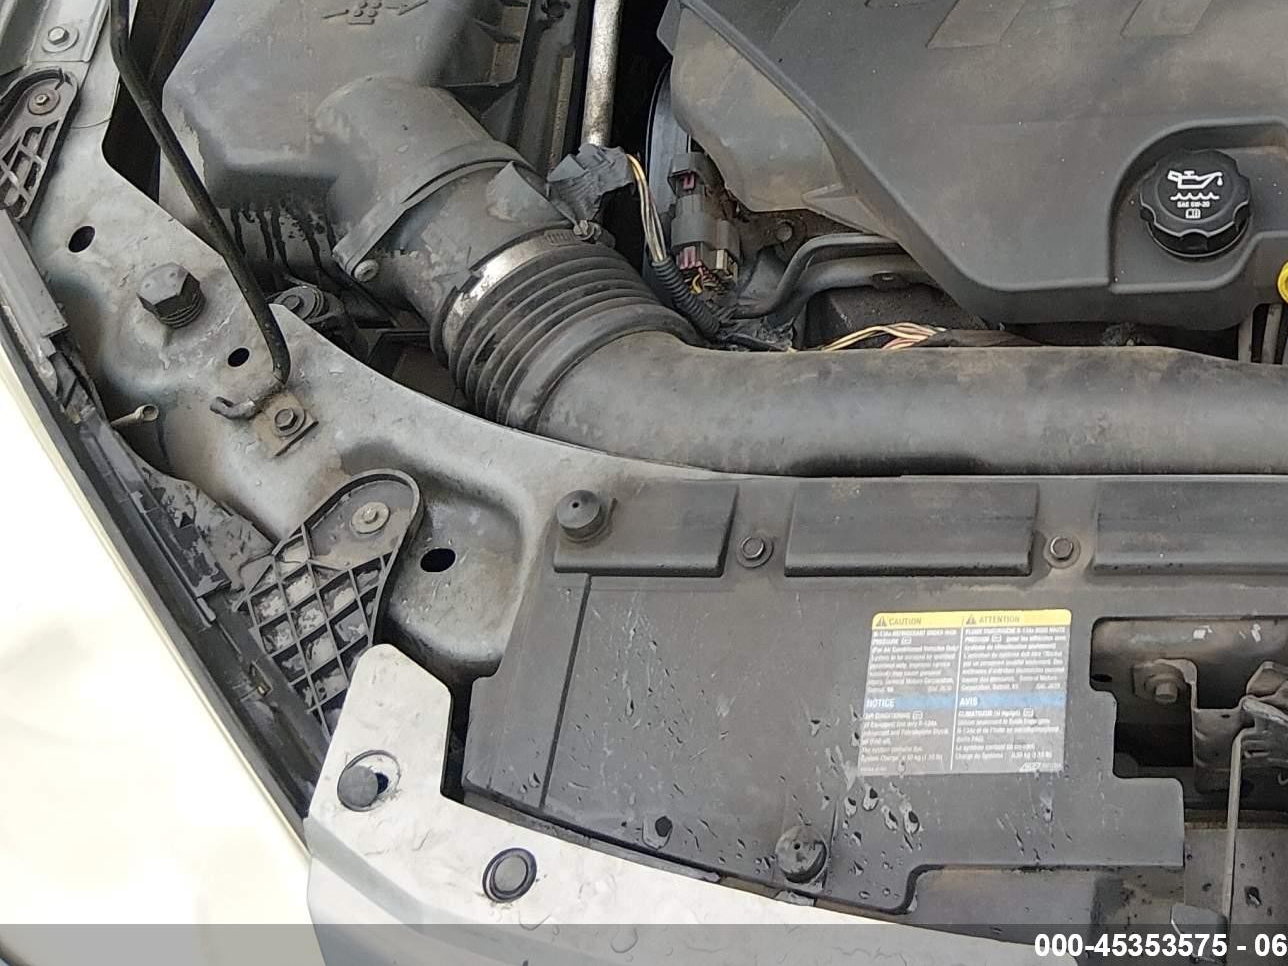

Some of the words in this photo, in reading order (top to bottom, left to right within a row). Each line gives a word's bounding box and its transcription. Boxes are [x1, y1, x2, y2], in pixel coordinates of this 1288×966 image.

[1177, 200, 1190, 208] SAE
[888, 617, 922, 626] CAUTION
[978, 615, 1020, 624] ATTENTION
[866, 698, 895, 709] NOTICE
[959, 696, 978, 707] AVIS
